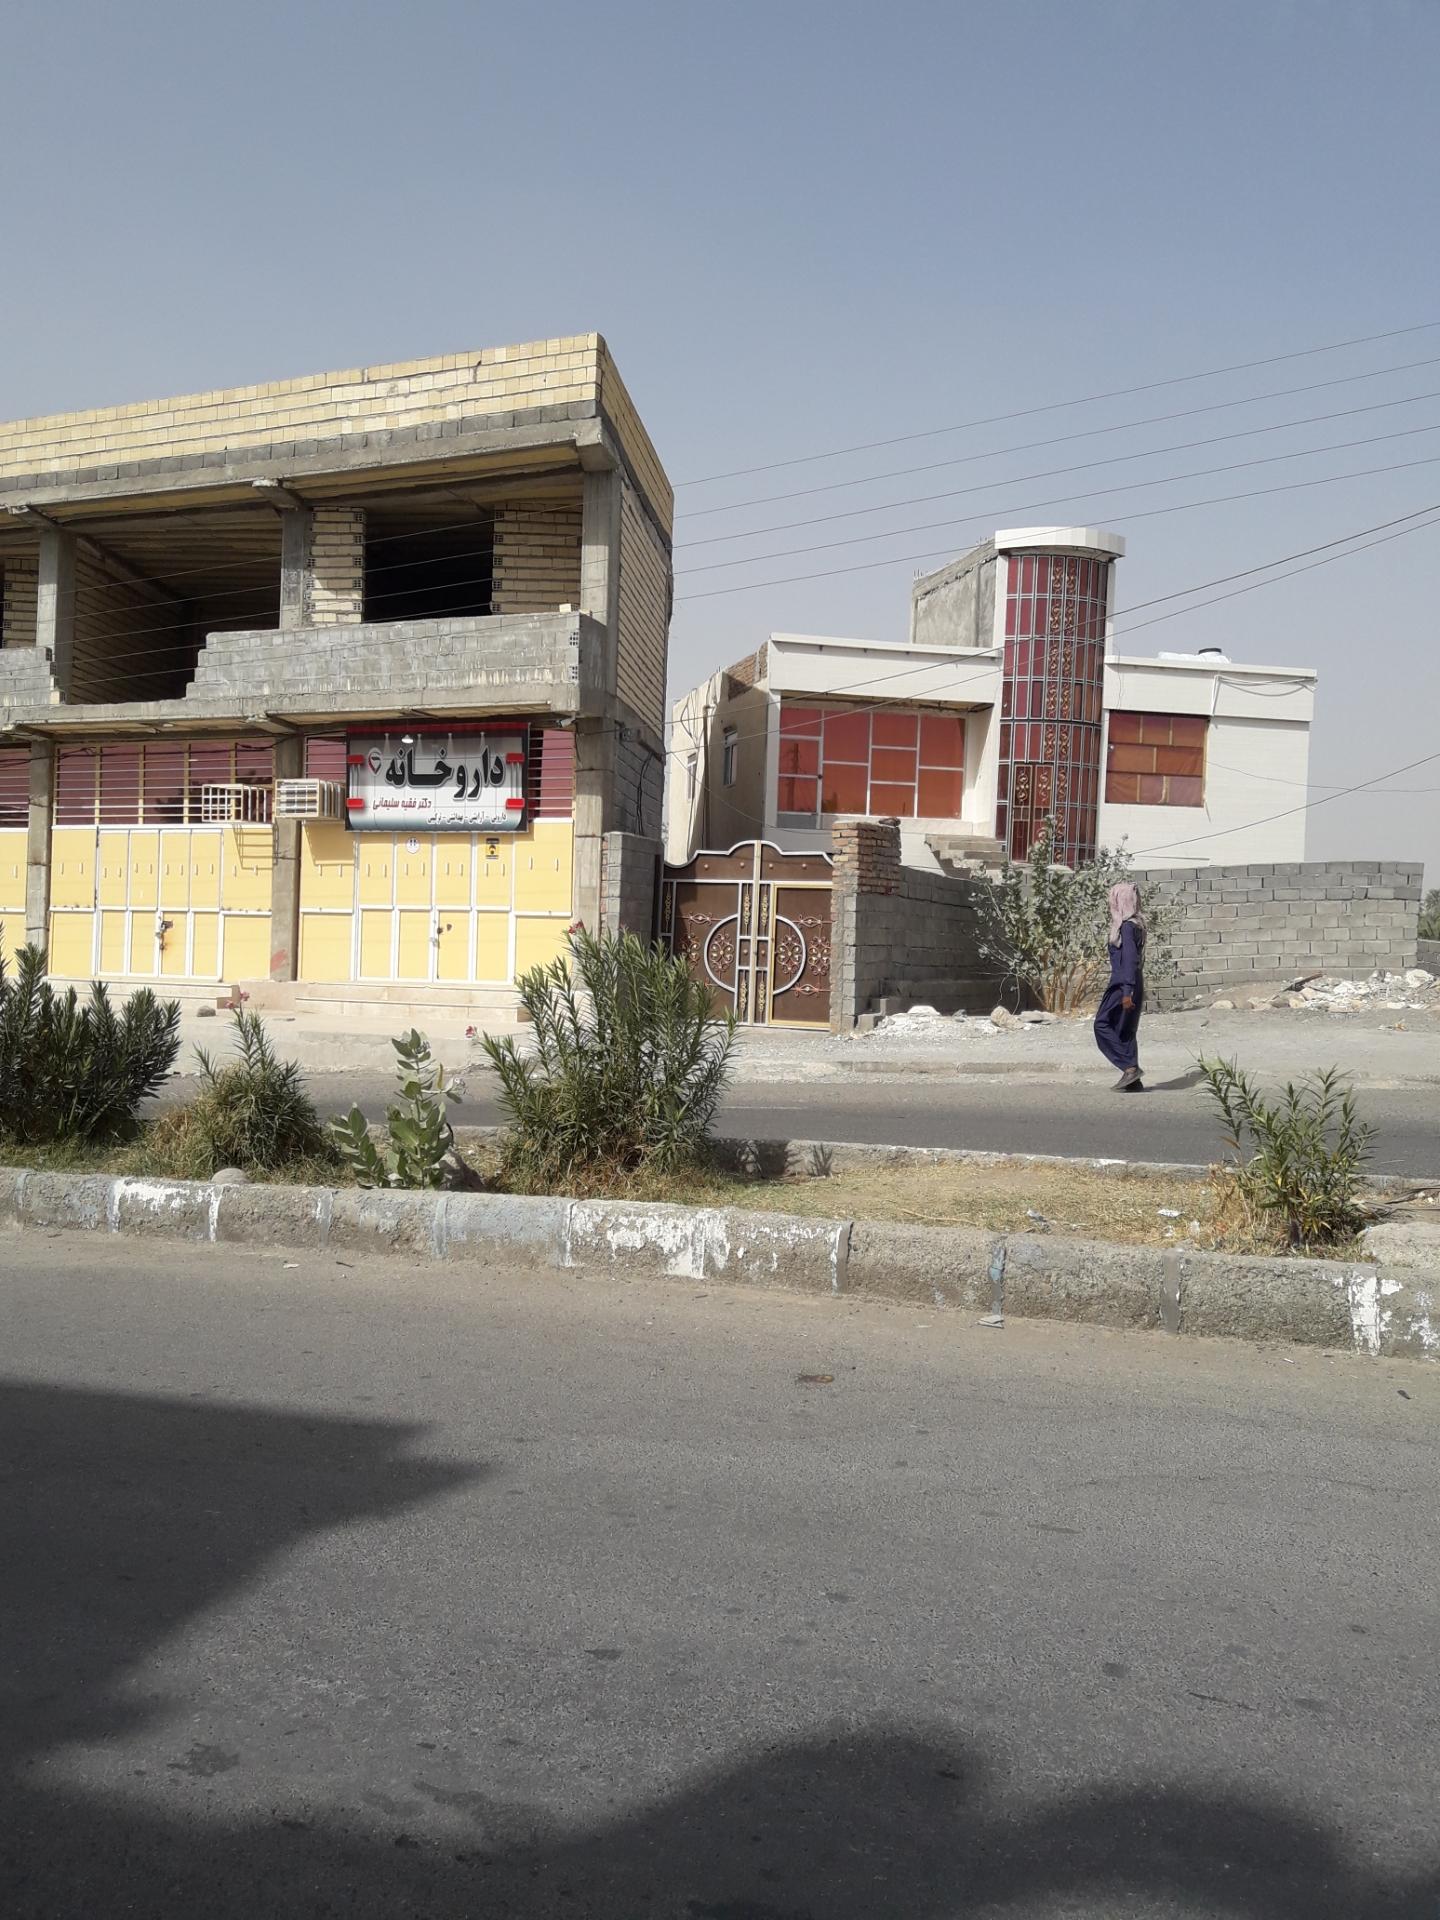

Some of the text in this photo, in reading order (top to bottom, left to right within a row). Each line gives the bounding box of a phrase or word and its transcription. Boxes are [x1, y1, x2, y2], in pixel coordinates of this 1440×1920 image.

[385, 745, 504, 799] داروخانه
[372, 796, 432, 811] دکتر فقیه سلیمانی
